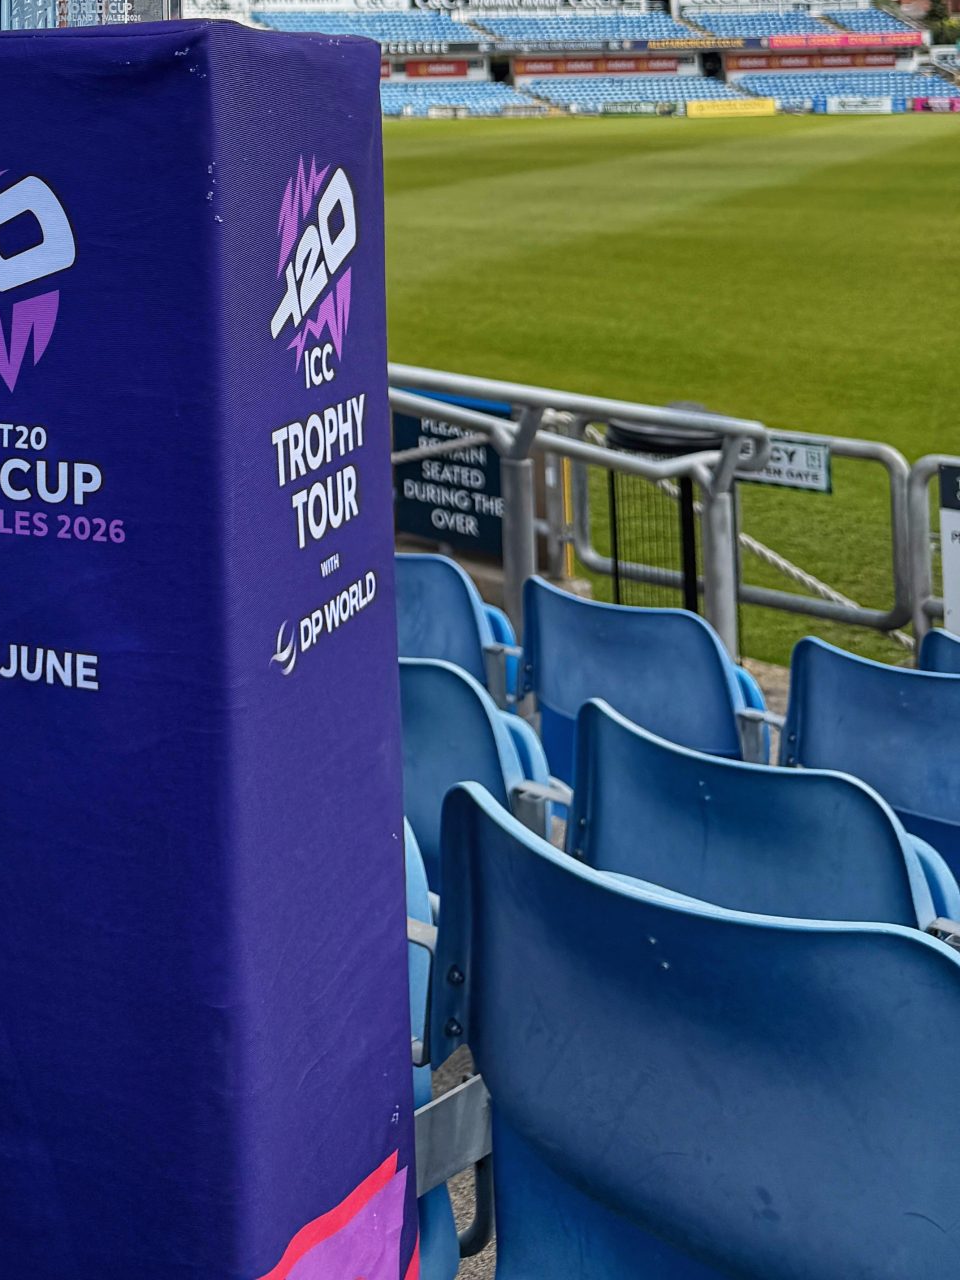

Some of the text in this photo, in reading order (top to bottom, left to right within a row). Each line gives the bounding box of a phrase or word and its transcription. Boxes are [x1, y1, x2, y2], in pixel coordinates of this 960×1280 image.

[57, 3, 133, 14] WORLD CUP
[270, 167, 357, 340] T20
[304, 342, 335, 389] ICC
[271, 393, 365, 487] TROPHY
[0, 458, 103, 505] CUP
[422, 459, 486, 489] SEATED
[292, 465, 359, 549] TOUR
[403, 479, 505, 519] DURING THE
[56, 514, 126, 544] 2026
[431, 508, 480, 538] OVER
[320, 553, 340, 578] WITH
[300, 571, 377, 653] DP WORLD
[0, 644, 100, 691] JUNE
